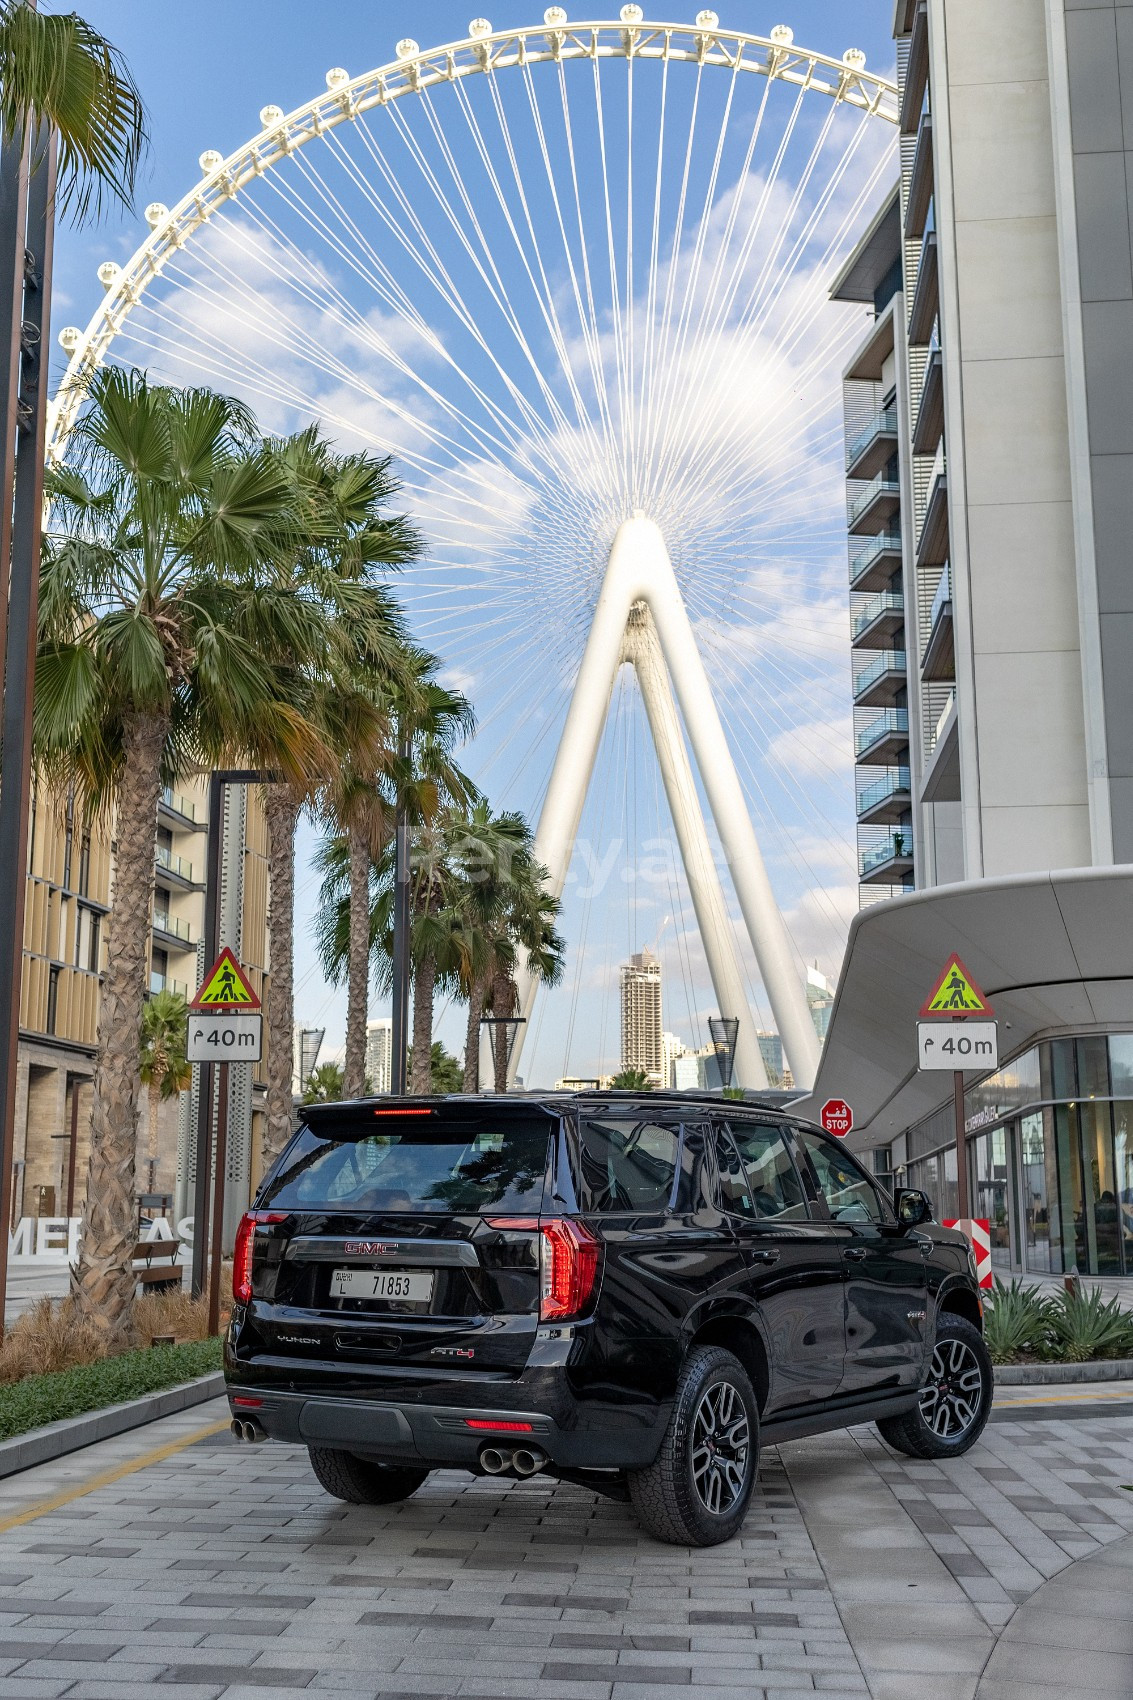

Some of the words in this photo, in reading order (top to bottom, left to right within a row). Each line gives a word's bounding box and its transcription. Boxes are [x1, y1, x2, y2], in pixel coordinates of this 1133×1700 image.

[207, 1030, 255, 1046] 40m
[941, 1037, 993, 1054] 40m
[826, 1105, 847, 1117] قف
[826, 1119, 849, 1130] STOP
[344, 1241, 399, 1256] GMC
[339, 1283, 347, 1295] L
[372, 1276, 410, 1296] 71853
[277, 1335, 321, 1345] YUKON
[430, 1346, 475, 1359] AT4
